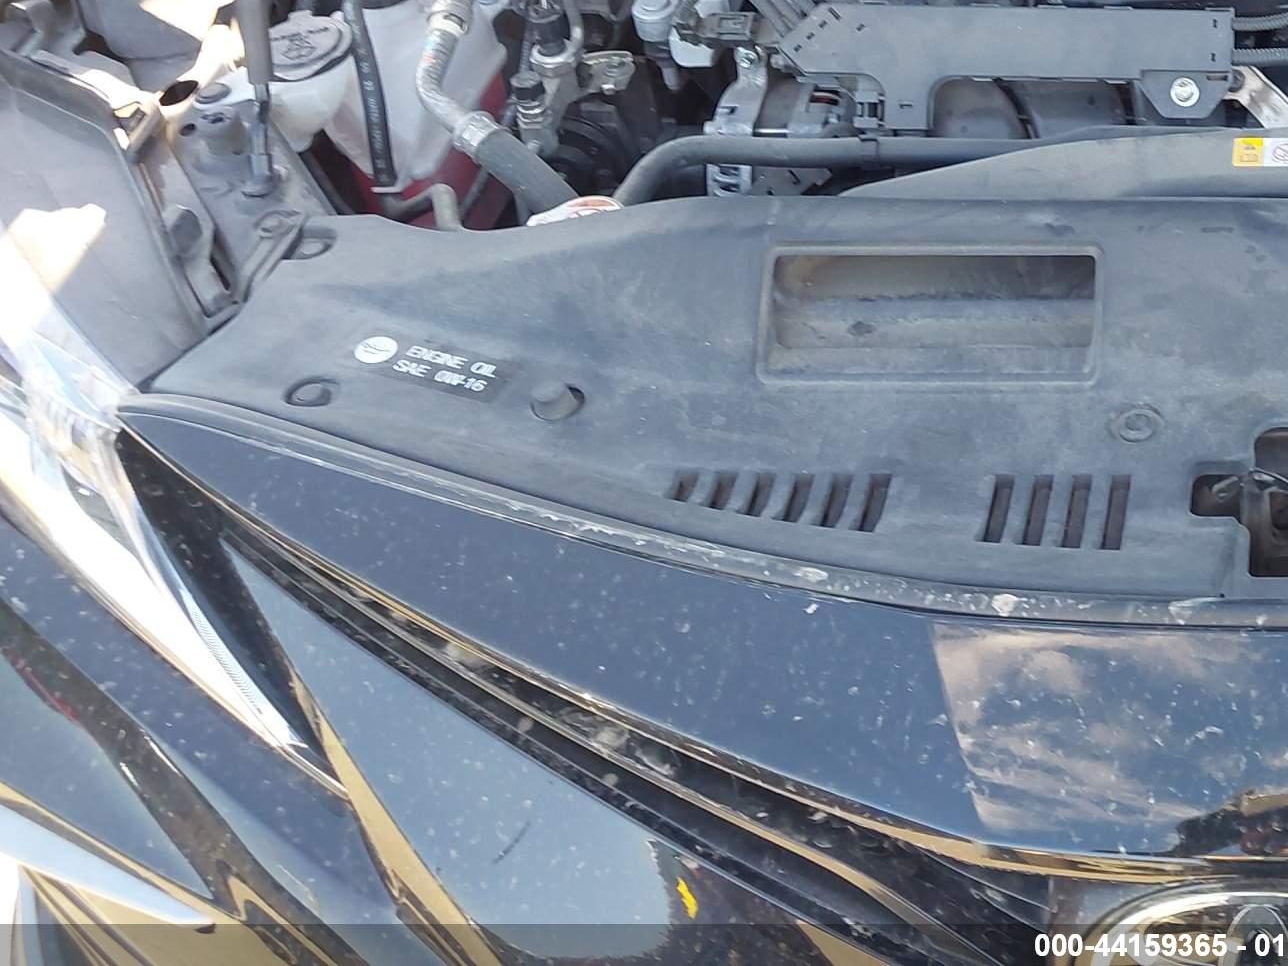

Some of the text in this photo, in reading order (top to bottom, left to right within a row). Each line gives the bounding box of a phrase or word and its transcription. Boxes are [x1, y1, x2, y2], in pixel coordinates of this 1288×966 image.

[392, 359, 432, 377] SAE
[406, 345, 497, 378] ENGINE OIL
